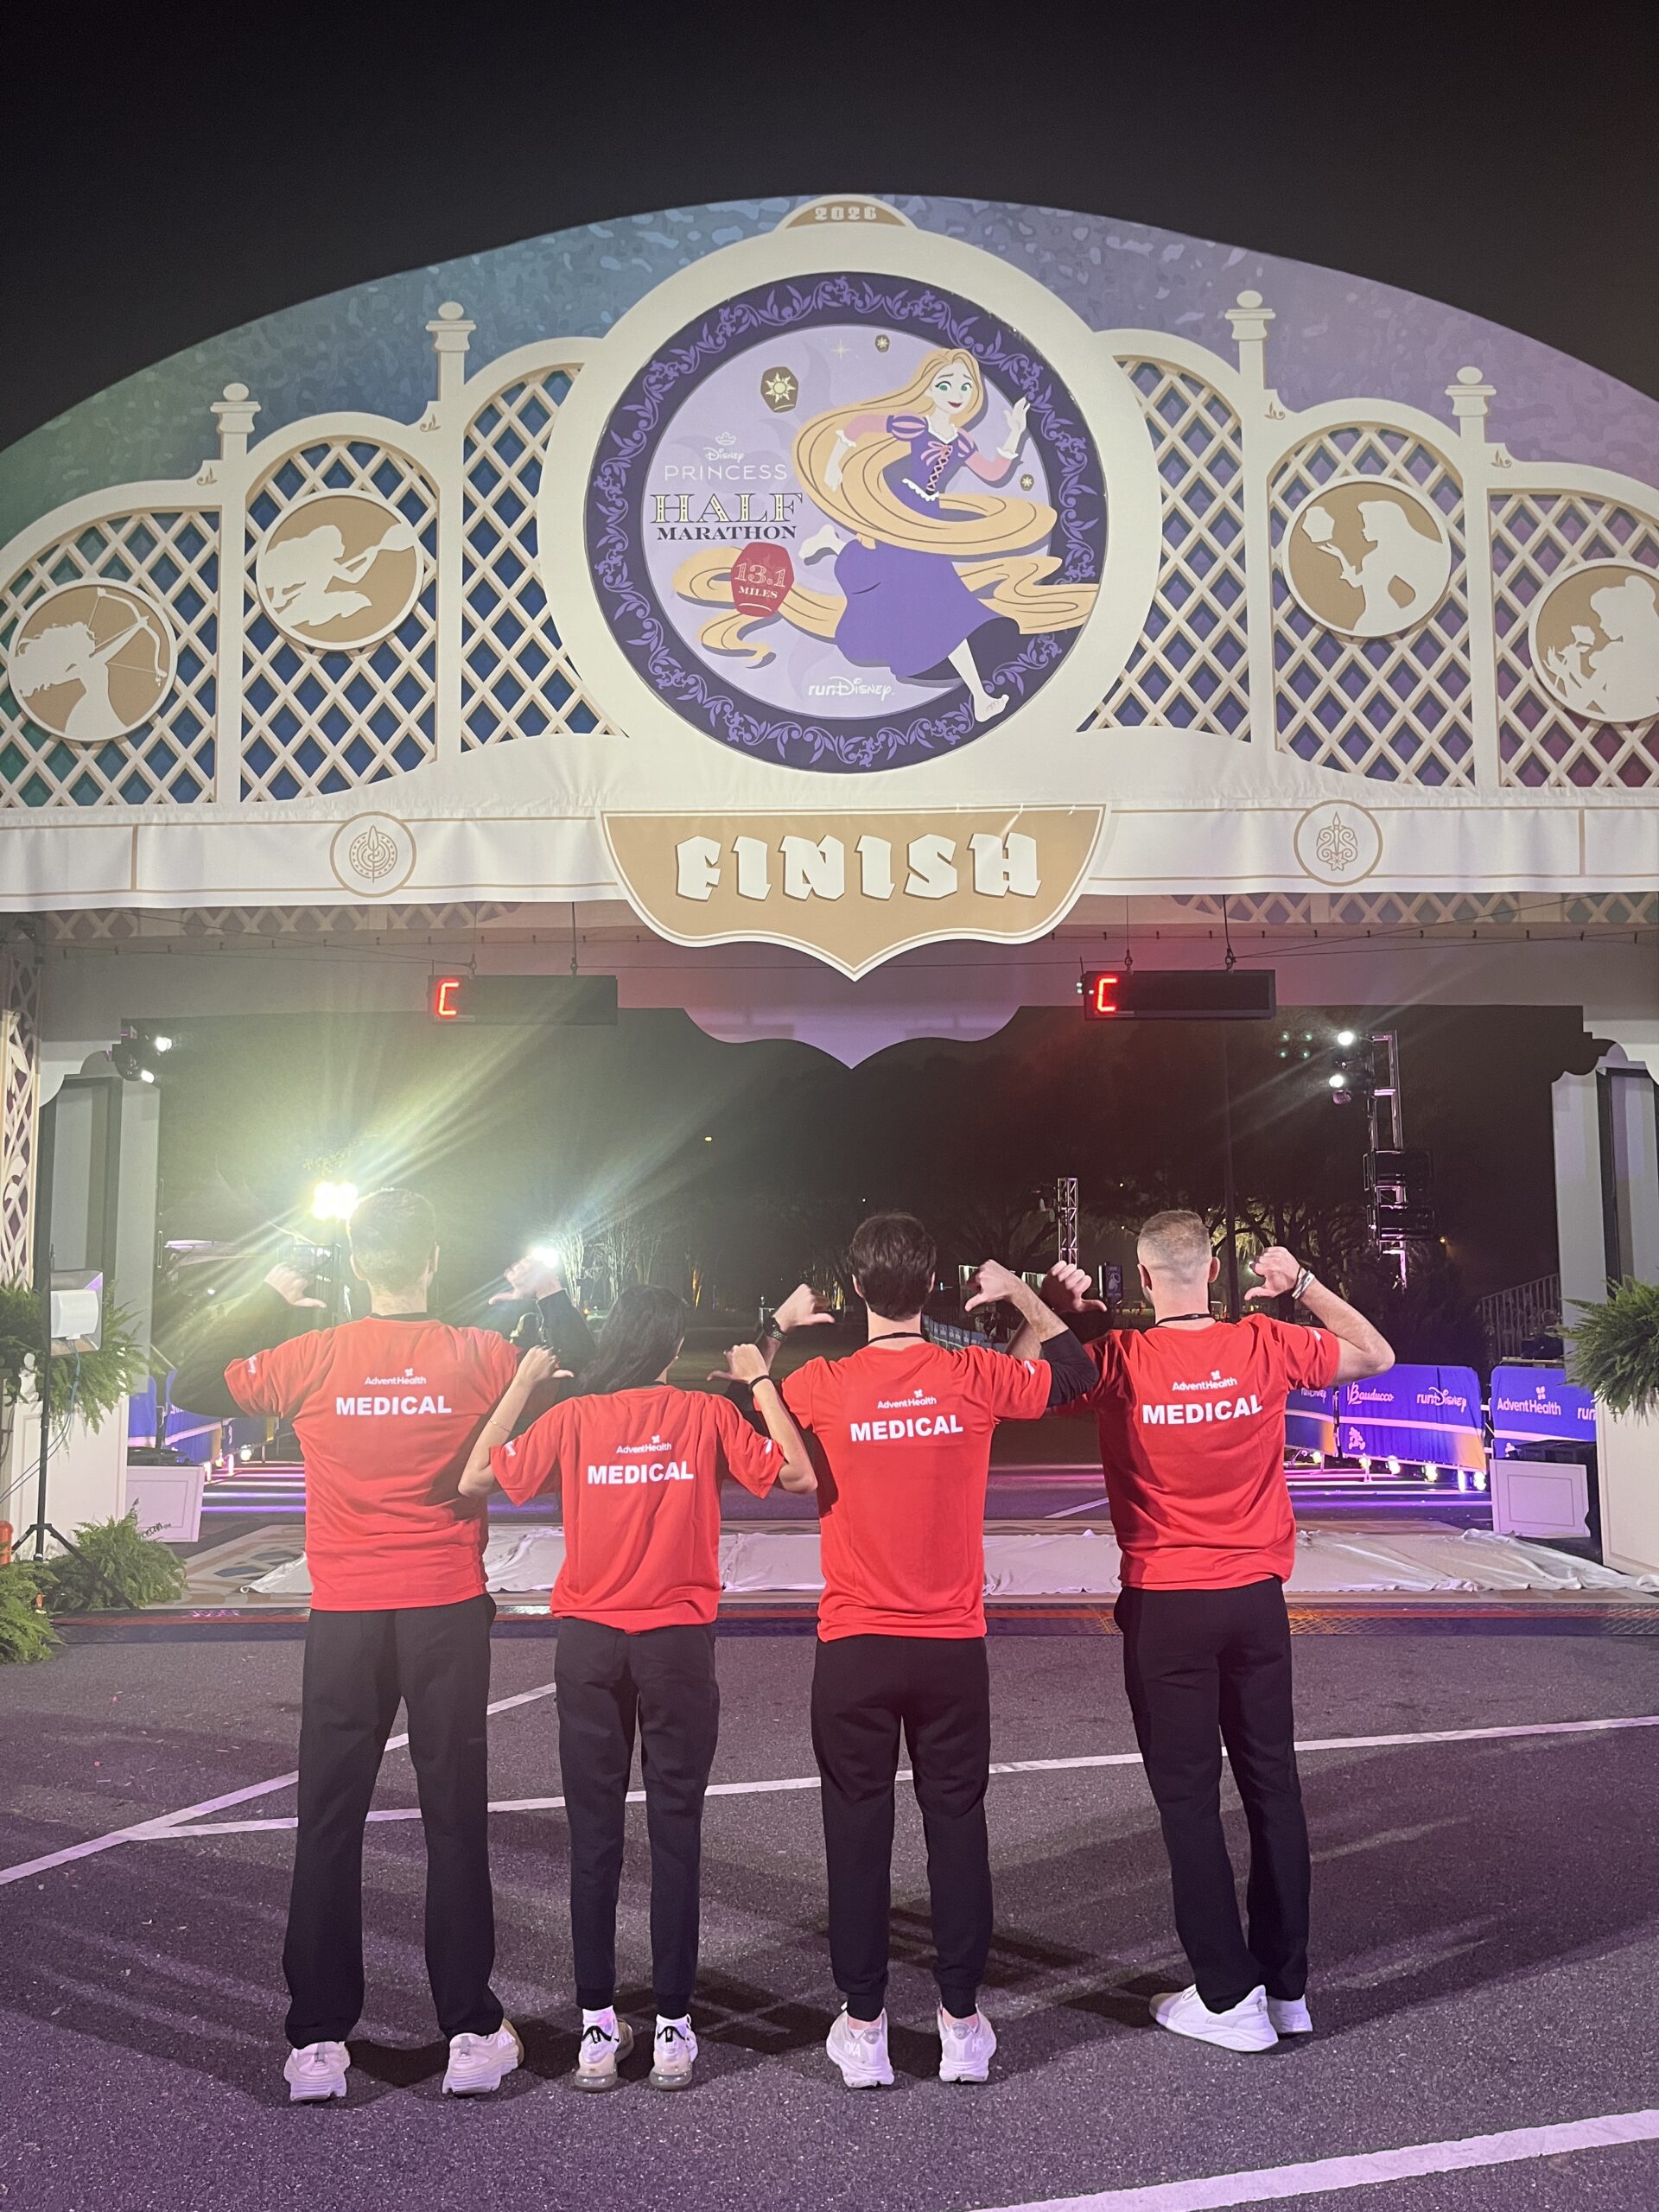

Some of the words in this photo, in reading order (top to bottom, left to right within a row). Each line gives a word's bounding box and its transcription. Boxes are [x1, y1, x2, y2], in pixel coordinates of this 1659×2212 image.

[815, 206, 877, 221] 2026
[664, 464, 787, 481] PRINCESS
[650, 492, 803, 523] HALF
[657, 525, 797, 540] MARATHON
[734, 563, 786, 588] 13.1
[739, 585, 779, 600] MILES
[675, 833, 1042, 901] FINISH
[335, 1395, 453, 1415] MEDICAL
[1142, 1394, 1262, 1425] MEDICAL
[1497, 1397, 1562, 1416] AdventHealth
[850, 1414, 963, 1442] MEDICAL
[588, 1460, 694, 1484] MEDICAL
